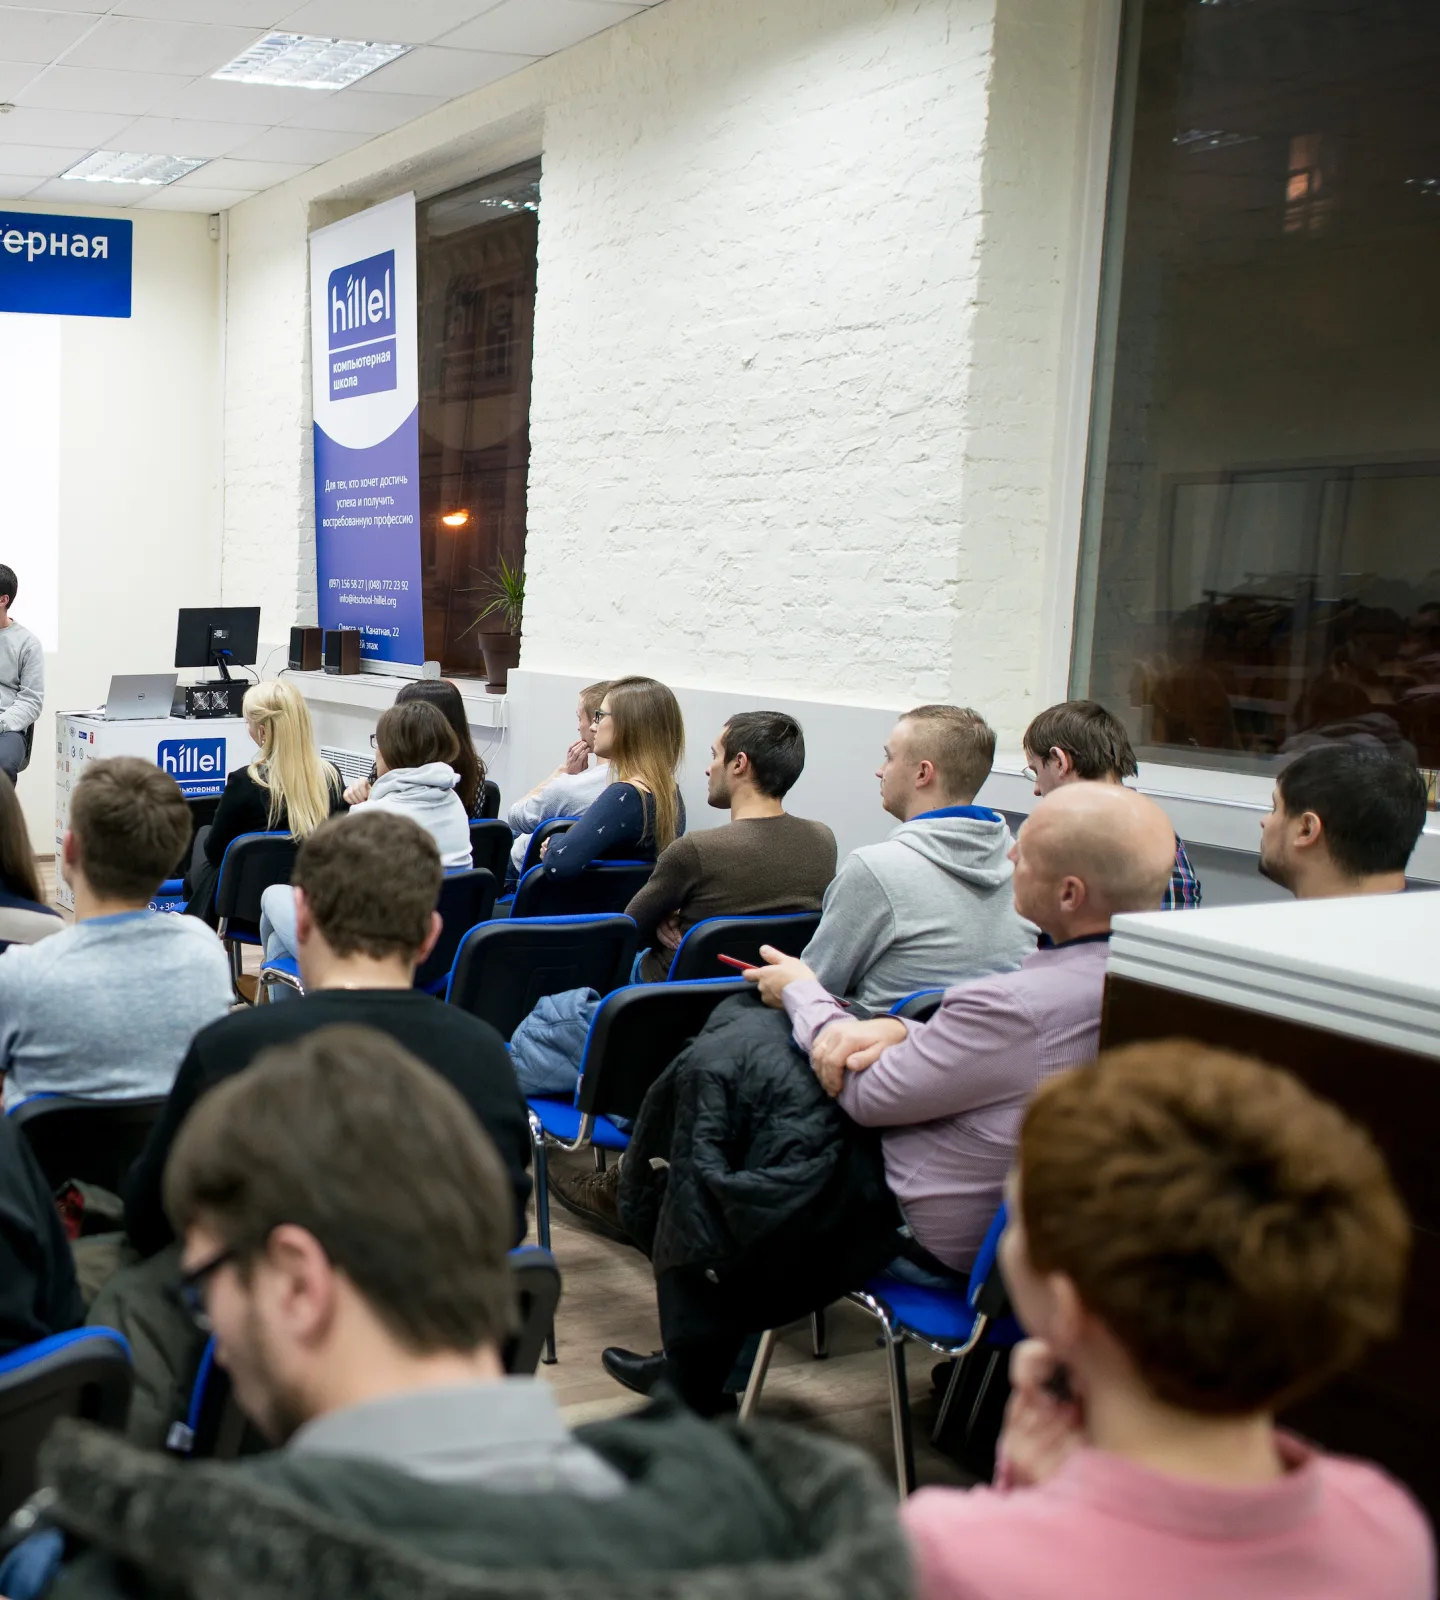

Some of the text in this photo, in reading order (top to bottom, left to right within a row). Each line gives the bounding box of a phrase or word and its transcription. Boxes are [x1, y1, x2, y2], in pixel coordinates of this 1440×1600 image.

[332, 268, 390, 333] hillel
[333, 350, 391, 374] компьютерная
[333, 376, 358, 390] школа
[325, 475, 408, 492] Для тех, кто хочет достичь
[336, 496, 394, 511] успеха и получить
[322, 513, 413, 529] востребованную профессию
[358, 579, 364, 589] 27
[382, 580, 392, 590] 772
[393, 580, 401, 590] 23
[401, 580, 409, 591] 92
[392, 627, 400, 637] 22
[163, 744, 221, 773] hillel
